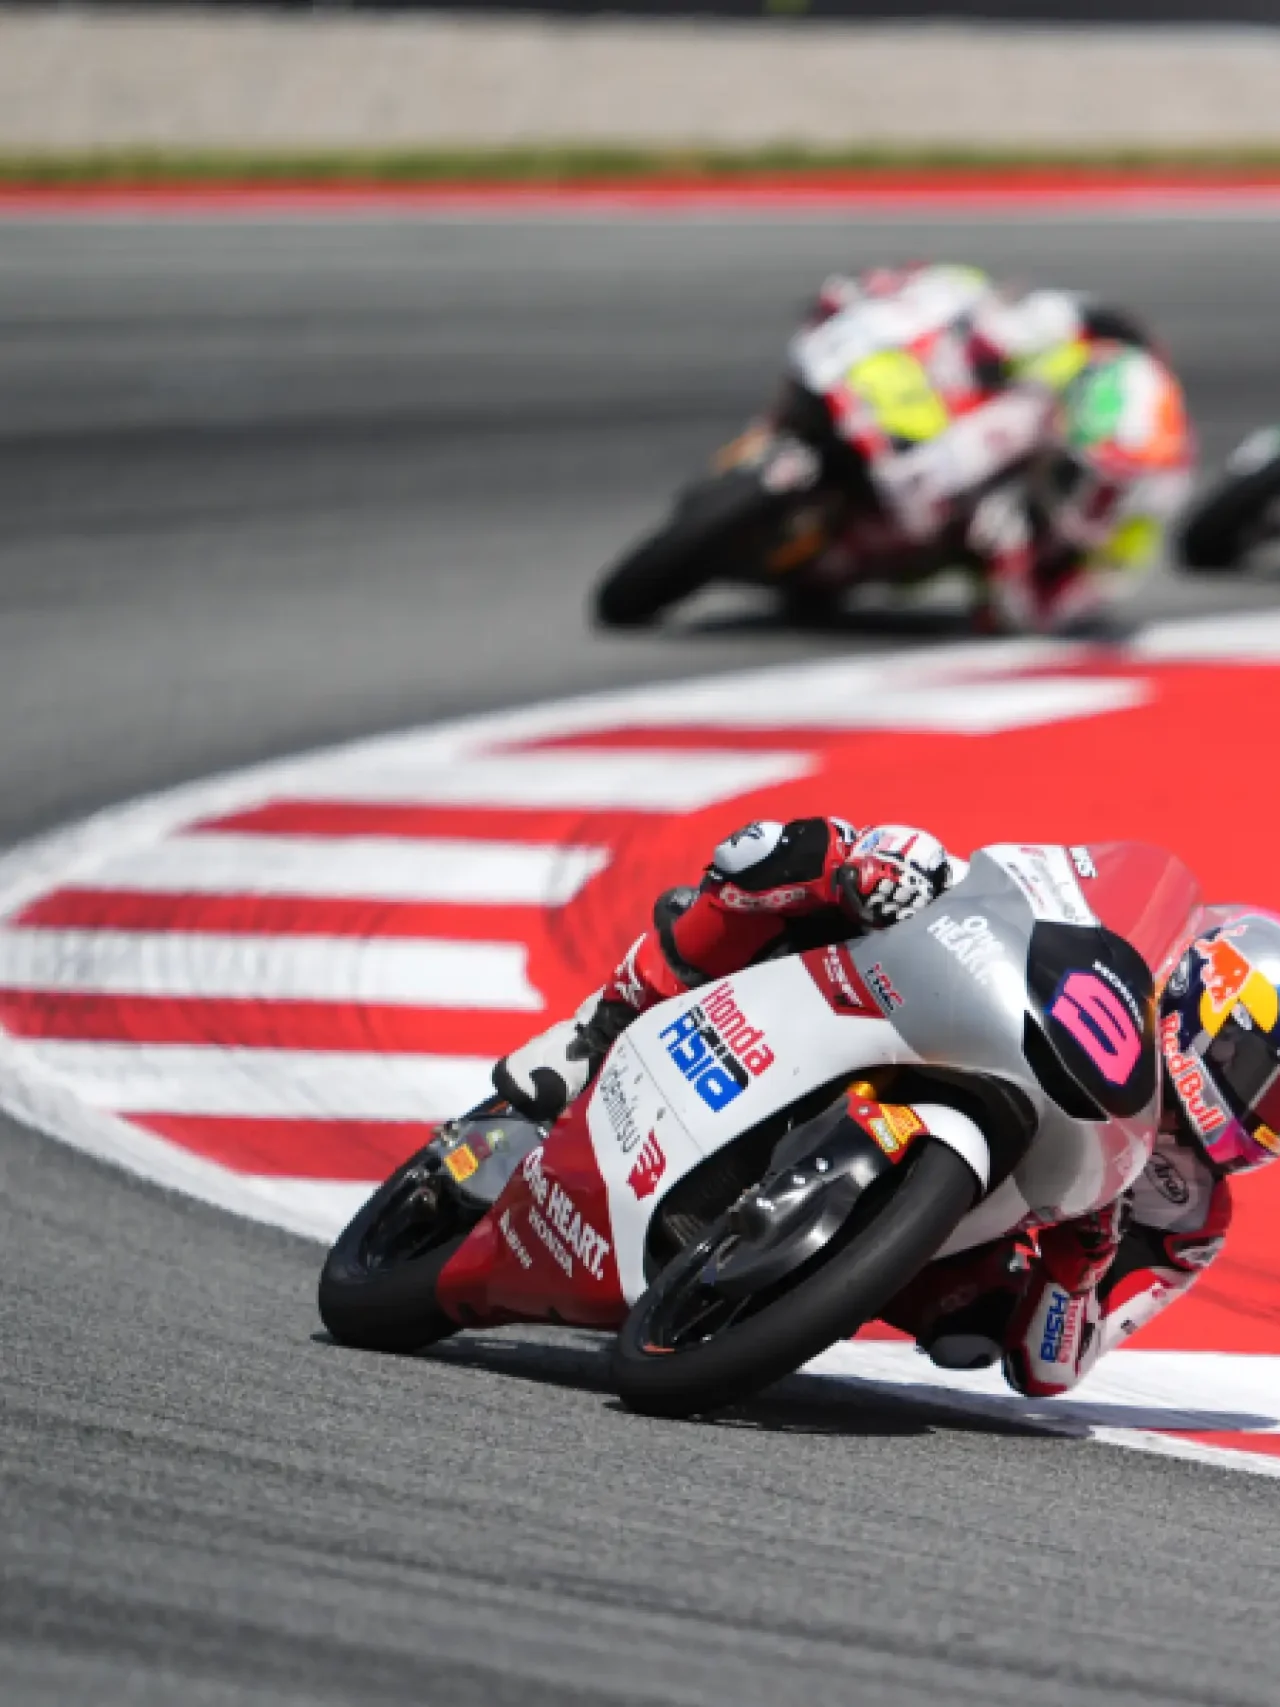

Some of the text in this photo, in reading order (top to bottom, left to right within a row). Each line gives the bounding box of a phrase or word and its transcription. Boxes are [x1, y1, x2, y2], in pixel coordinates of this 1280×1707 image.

[699, 981, 776, 1078] Honda
[1160, 1009, 1197, 1078] Red
[1175, 1070, 1228, 1134] Bull
